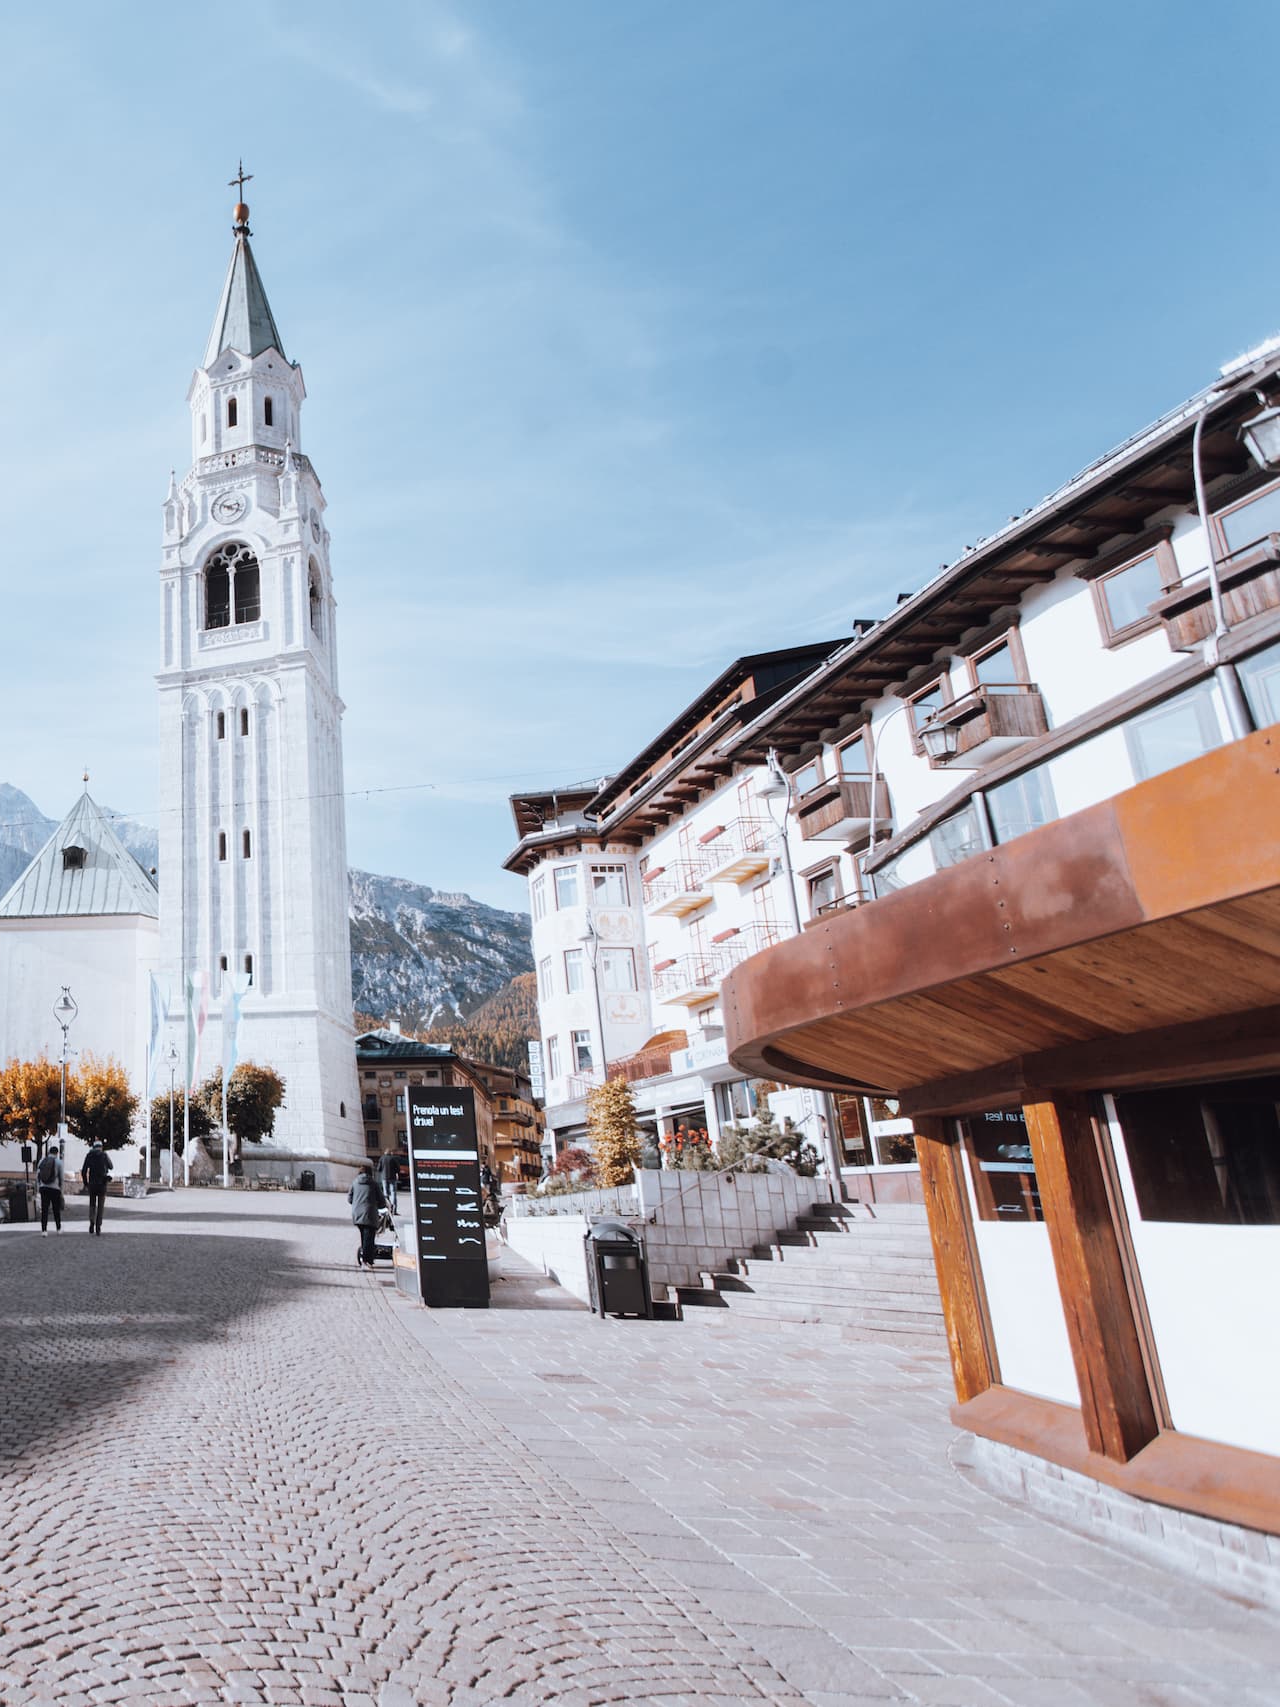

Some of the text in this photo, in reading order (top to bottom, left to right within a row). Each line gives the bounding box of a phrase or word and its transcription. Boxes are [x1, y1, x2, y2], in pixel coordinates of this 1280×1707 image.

[530, 1043, 541, 1097] SPORT
[440, 1107, 450, 1116] un
[450, 1105, 464, 1116] test
